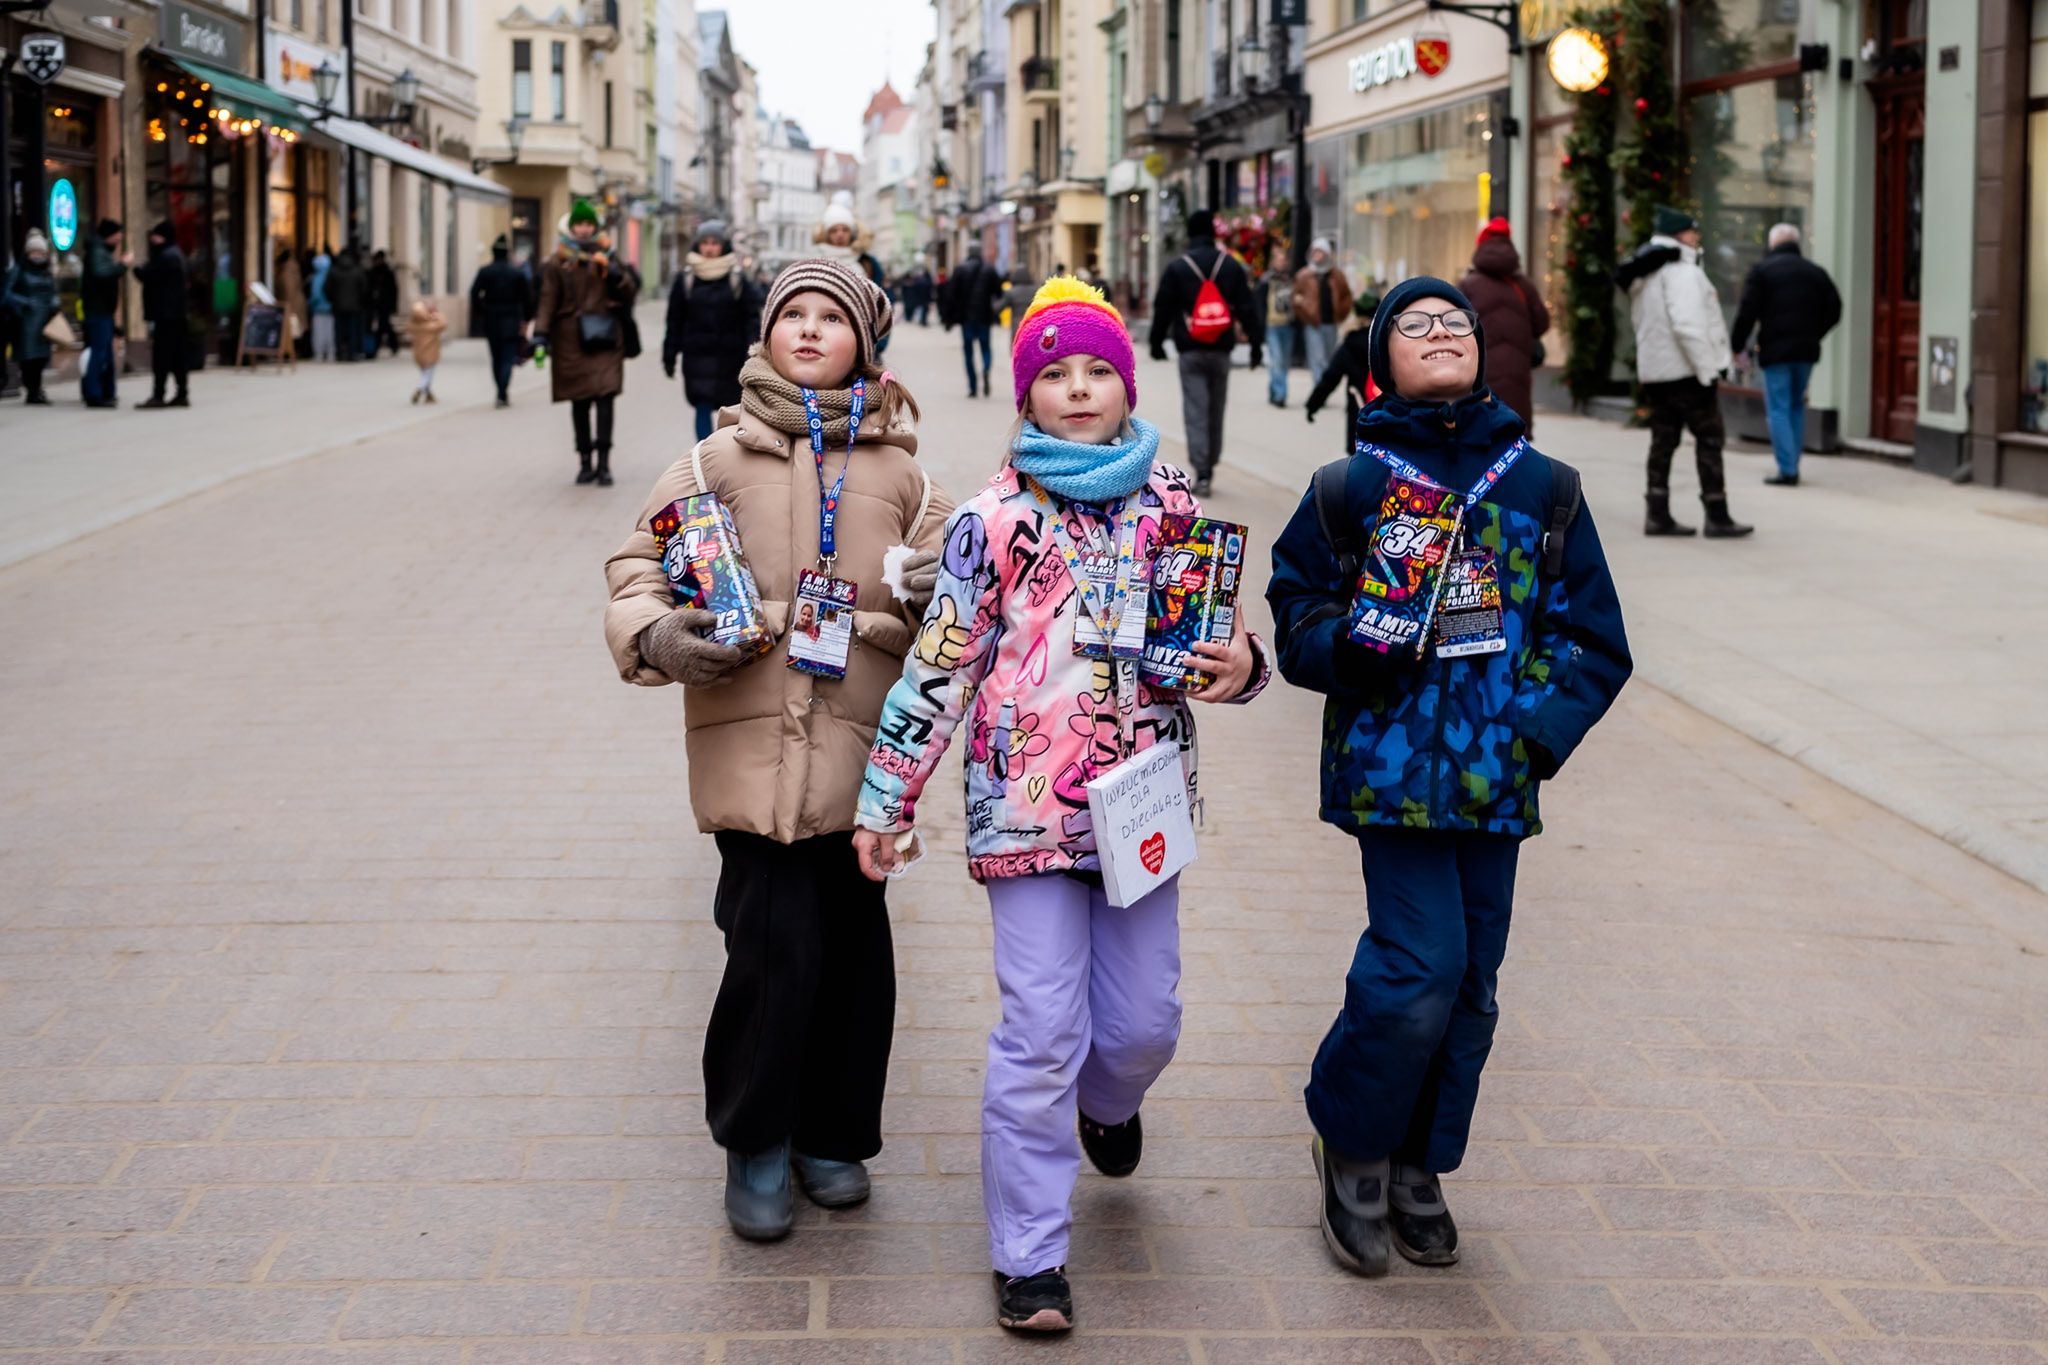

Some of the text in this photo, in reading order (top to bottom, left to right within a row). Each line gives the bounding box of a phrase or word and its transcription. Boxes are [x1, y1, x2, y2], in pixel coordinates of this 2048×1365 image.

[1403, 464, 1418, 477] 112
[1380, 520, 1441, 560] 34
[667, 526, 703, 582] 34
[1085, 556, 1095, 566] A
[804, 574, 814, 583] A
[1153, 549, 1197, 590] 34
[1448, 560, 1474, 585] 34
[832, 584, 853, 598] 34
[1447, 586, 1457, 598] A
[1361, 608, 1379, 625] A
[1377, 614, 1420, 636] MY?
[1144, 644, 1191, 666] A MY?
[1157, 663, 1187, 677] SWOJE
[1130, 784, 1150, 810] DLA
